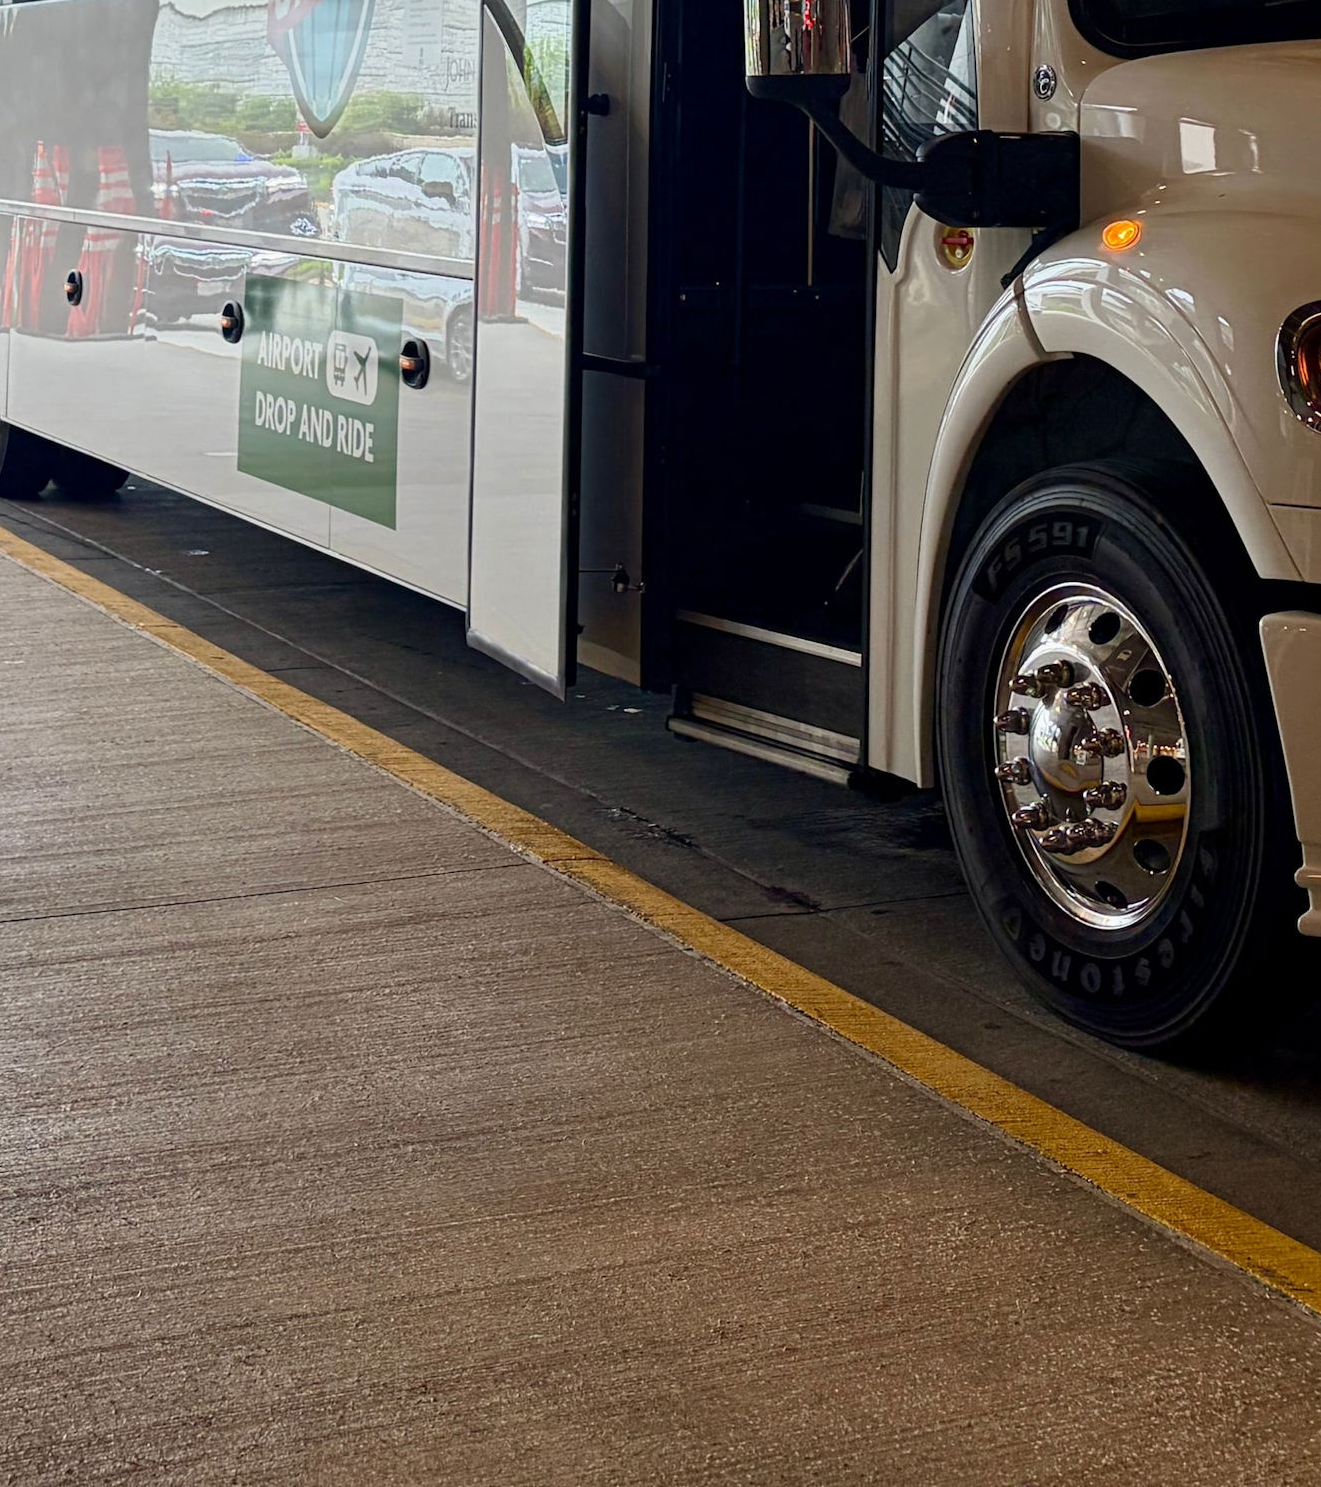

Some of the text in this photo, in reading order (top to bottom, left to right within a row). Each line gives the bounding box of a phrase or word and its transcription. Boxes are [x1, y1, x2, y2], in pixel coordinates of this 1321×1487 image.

[257, 330, 324, 380] AIRPORT
[255, 390, 375, 463] DROP AND RIDE
[1027, 521, 1090, 553] 591
